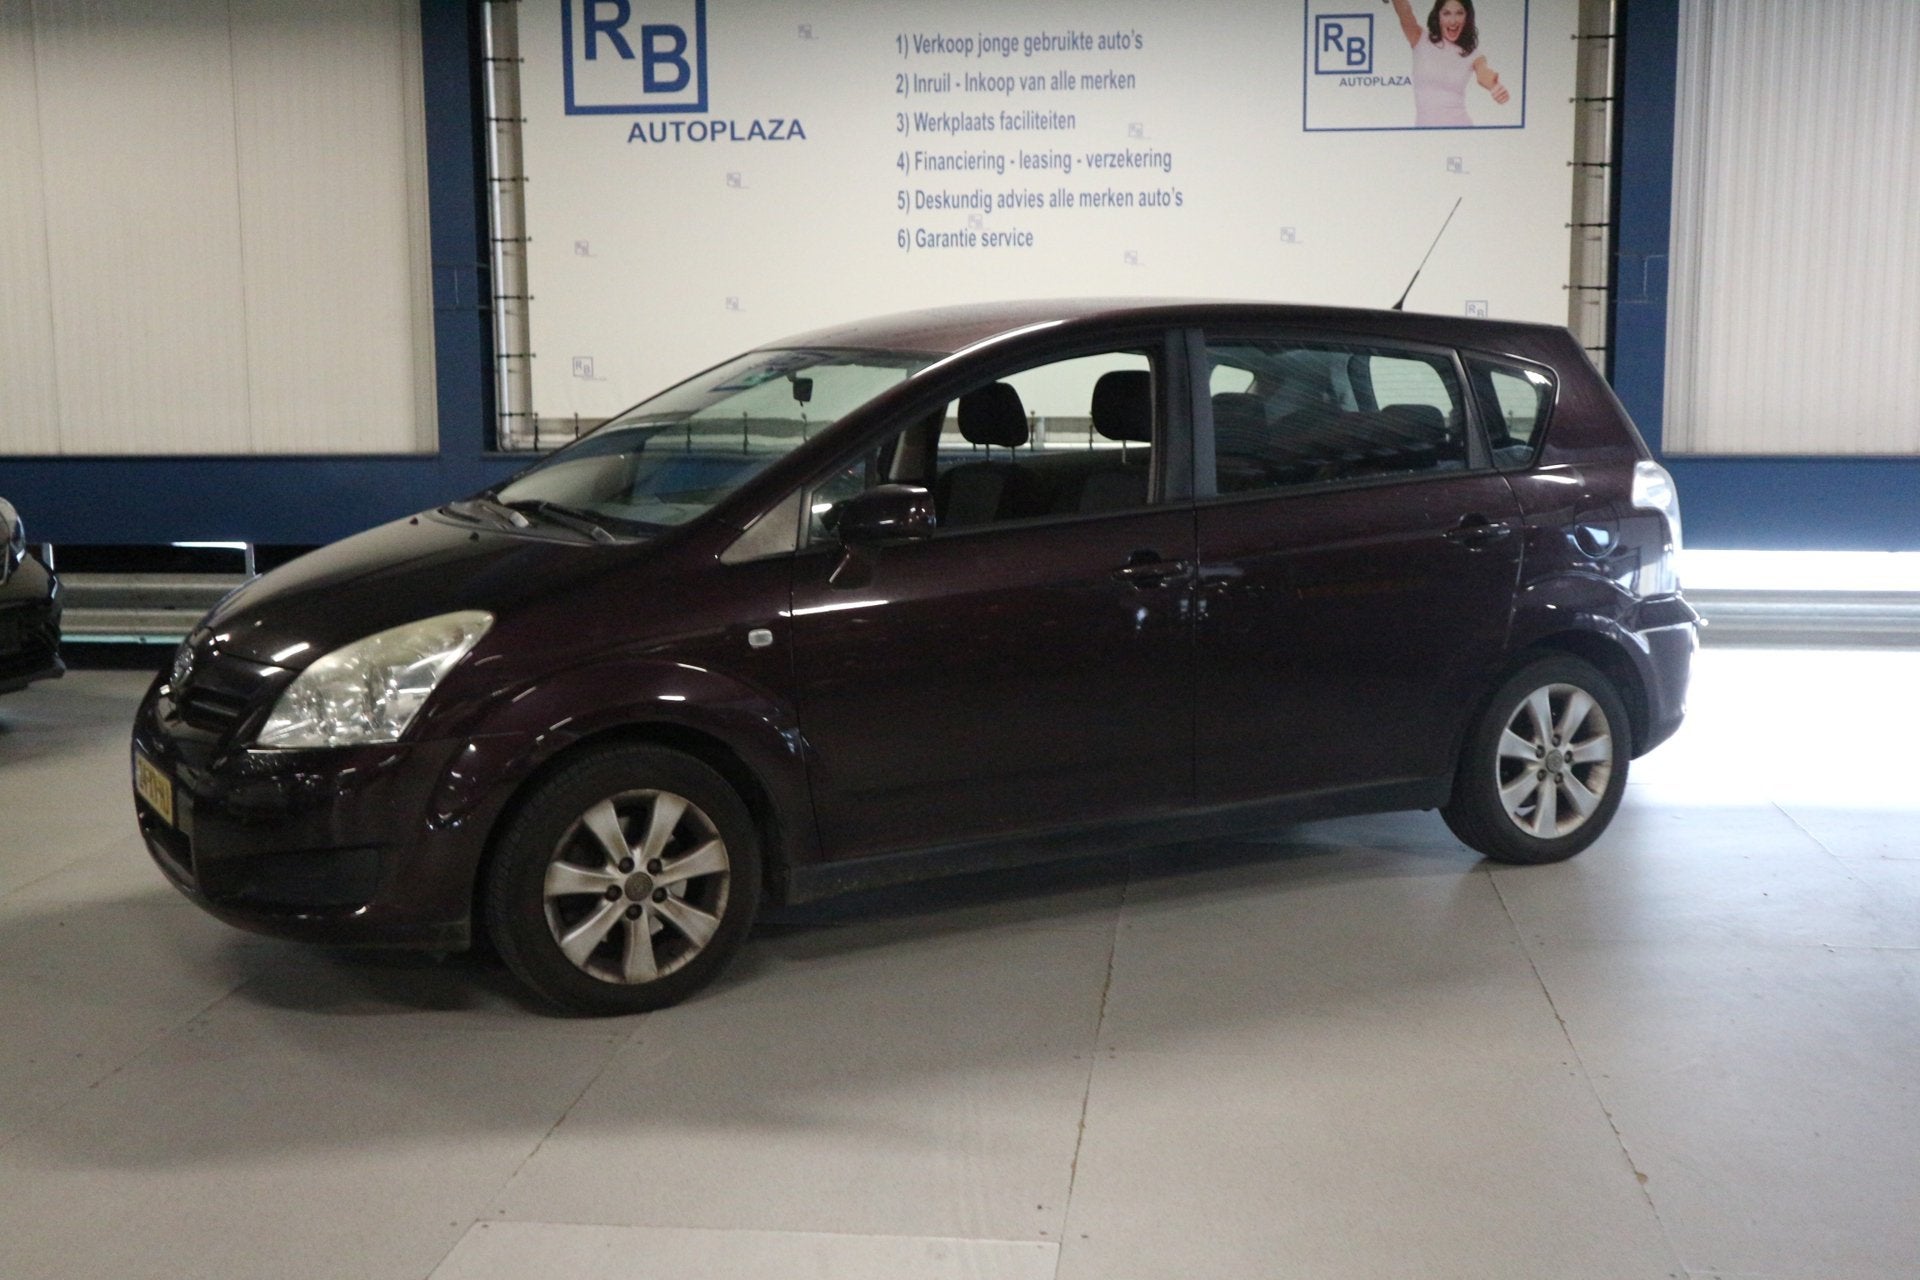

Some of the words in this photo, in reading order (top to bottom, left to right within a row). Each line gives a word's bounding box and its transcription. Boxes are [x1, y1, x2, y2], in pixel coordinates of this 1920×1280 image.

[895, 34, 909, 59] 1)
[912, 33, 974, 57] Verkoop
[977, 33, 1019, 58] jonge
[1023, 31, 1094, 57] gebruikte
[1324, 23, 1367, 66] RB
[895, 73, 909, 98] 2)
[913, 73, 951, 93] Inruil
[965, 72, 1015, 96] Inkoop
[1019, 75, 1046, 91] van
[1050, 71, 1076, 91] alle
[1080, 70, 1136, 90] merken
[1339, 76, 1412, 87] AUTOPLAZA
[628, 119, 806, 144] AUTOPLAZA
[896, 112, 910, 137] 3)
[913, 112, 995, 136] Werkplaats
[999, 110, 1076, 131] faciliteiten
[896, 151, 910, 175] 4)
[914, 150, 1005, 176] Financiering
[1019, 150, 1072, 175] leasing
[1085, 148, 1172, 174] verzekering
[897, 189, 911, 214] 5)
[915, 189, 993, 214] Deskundig
[997, 189, 1045, 209] advies
[1049, 188, 1075, 208] alle
[1079, 187, 1134, 208] merken
[897, 228, 911, 253] 6)
[915, 227, 977, 249] Garantie
[981, 228, 1034, 248] service
